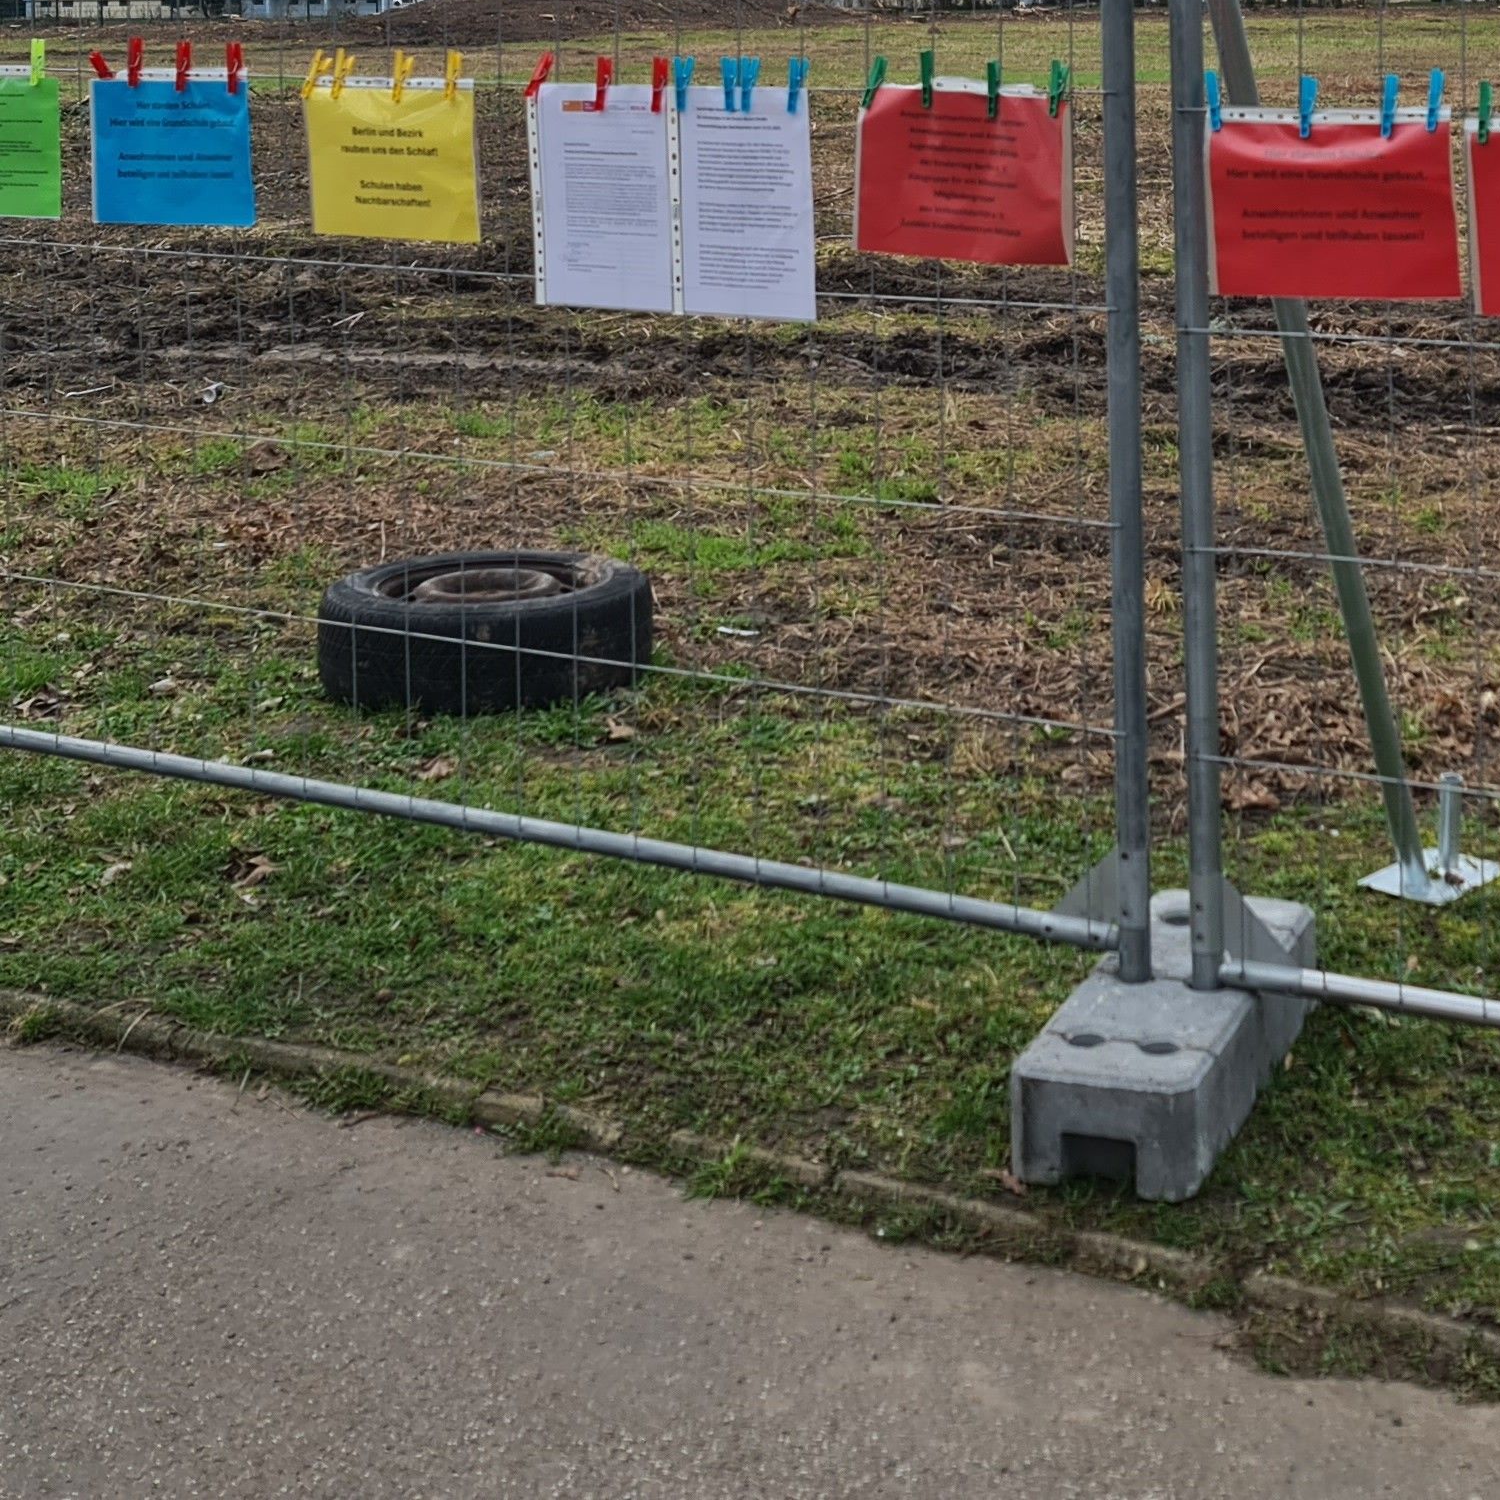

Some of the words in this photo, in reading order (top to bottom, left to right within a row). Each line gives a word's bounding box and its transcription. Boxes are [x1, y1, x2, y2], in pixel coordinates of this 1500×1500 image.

[352, 126, 377, 136] Berlin
[378, 128, 395, 137] und
[396, 128, 424, 138] Bezirk
[388, 146, 404, 155] den
